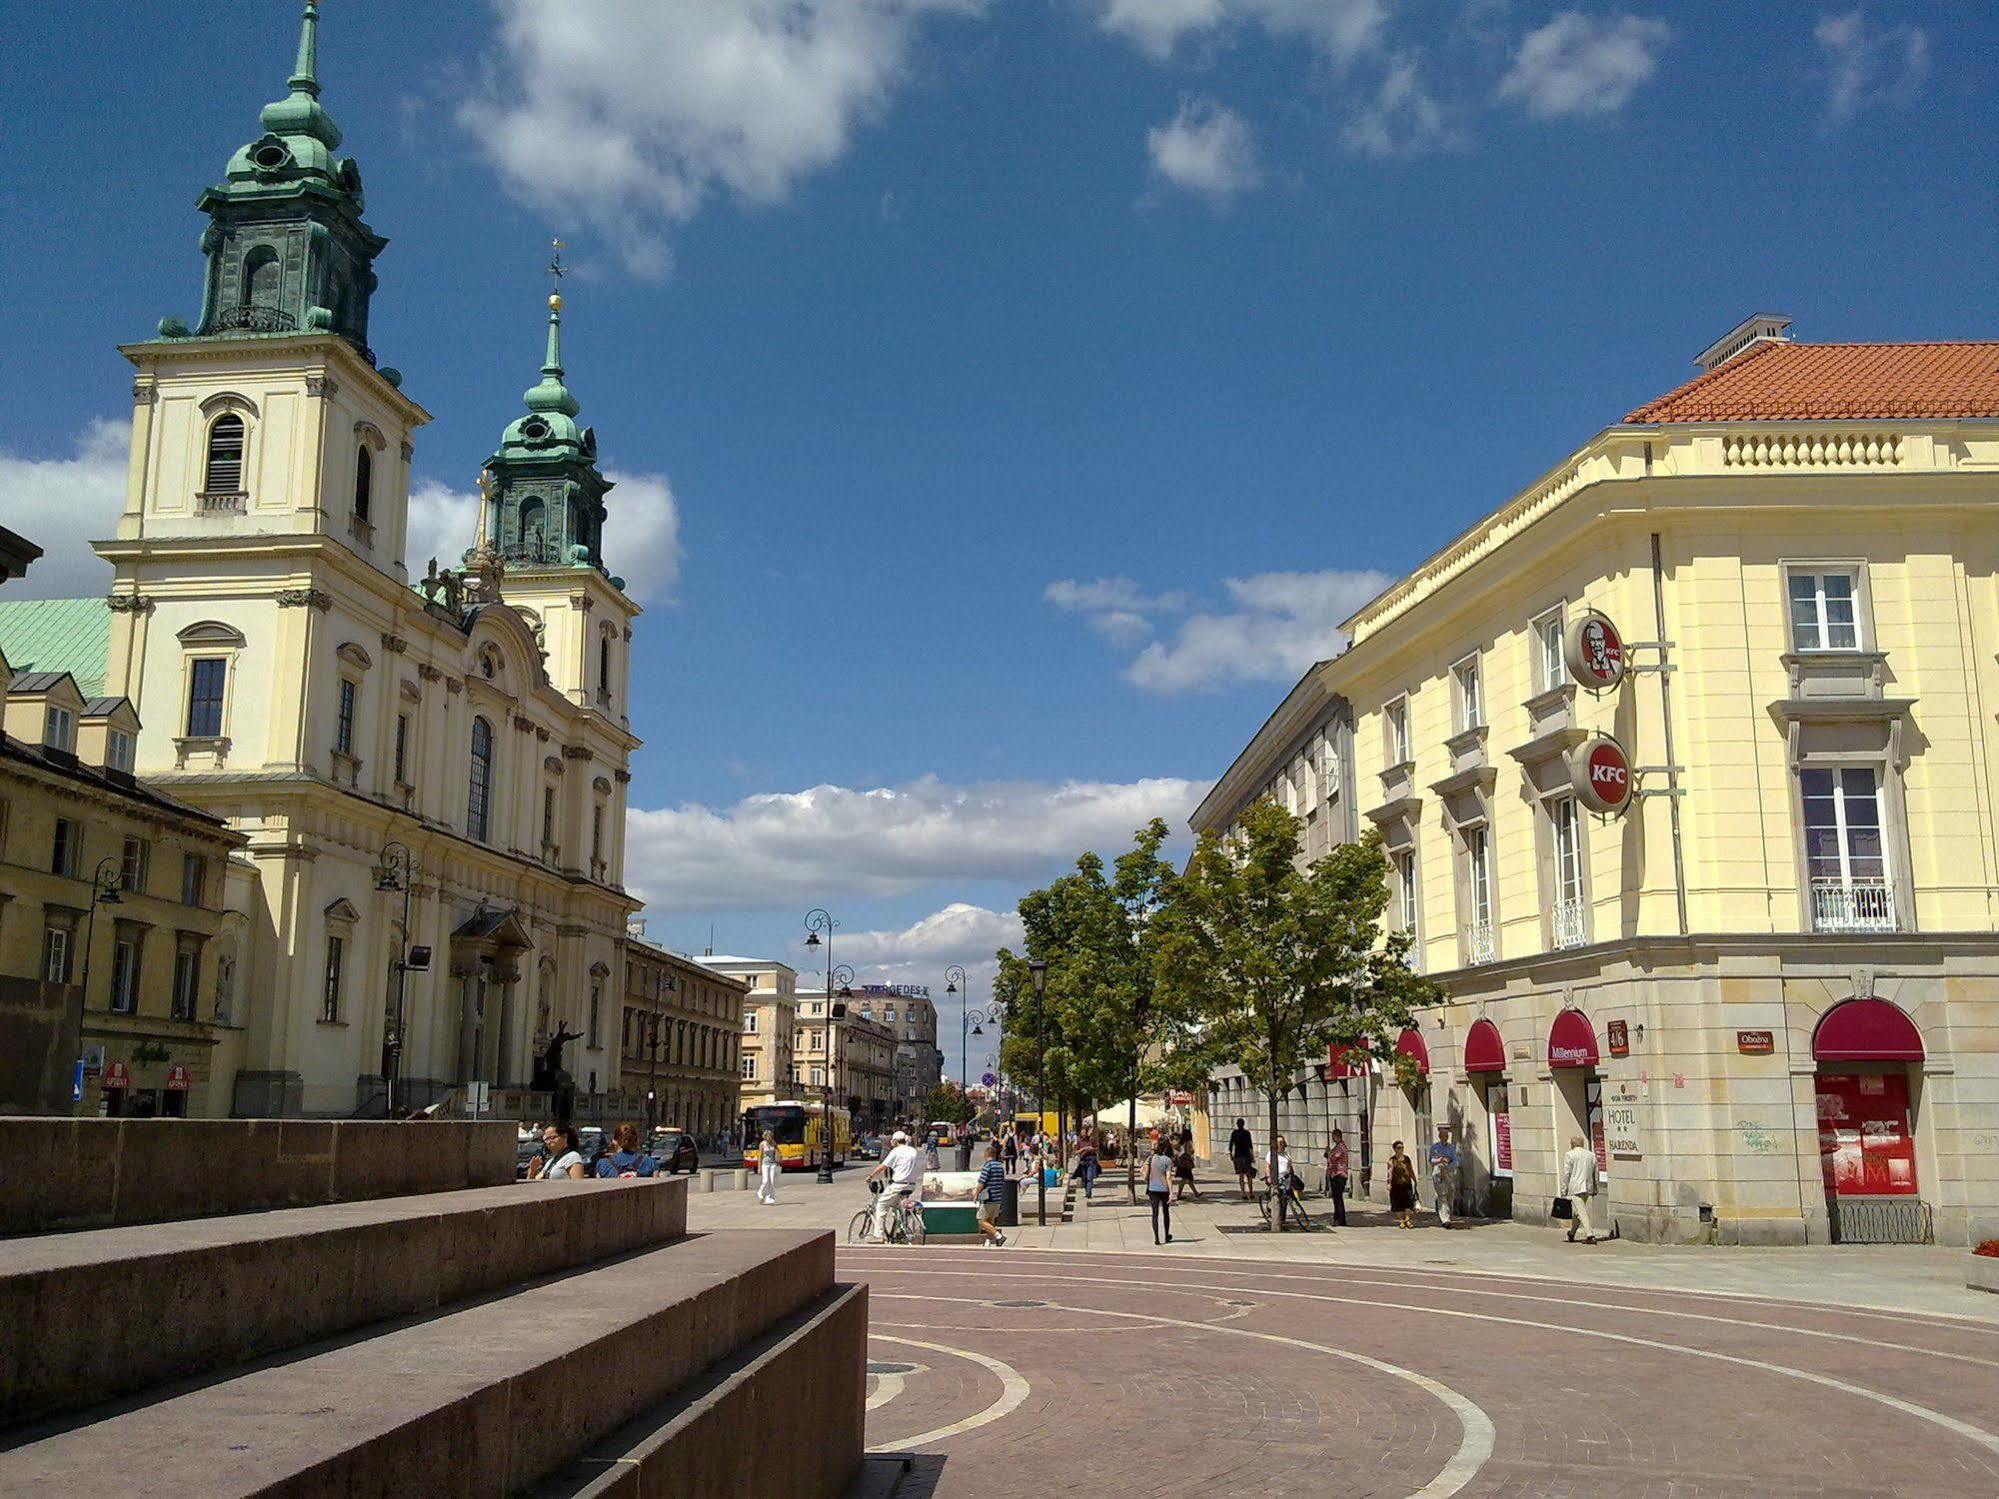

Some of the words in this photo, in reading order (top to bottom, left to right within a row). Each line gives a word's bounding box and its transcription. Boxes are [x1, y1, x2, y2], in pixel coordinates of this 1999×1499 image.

[1606, 647, 1620, 656] KFC
[1592, 765, 1626, 784] KFC
[1552, 1046, 1588, 1058] Millennium
[1608, 1110, 1635, 1124] HOTEL
